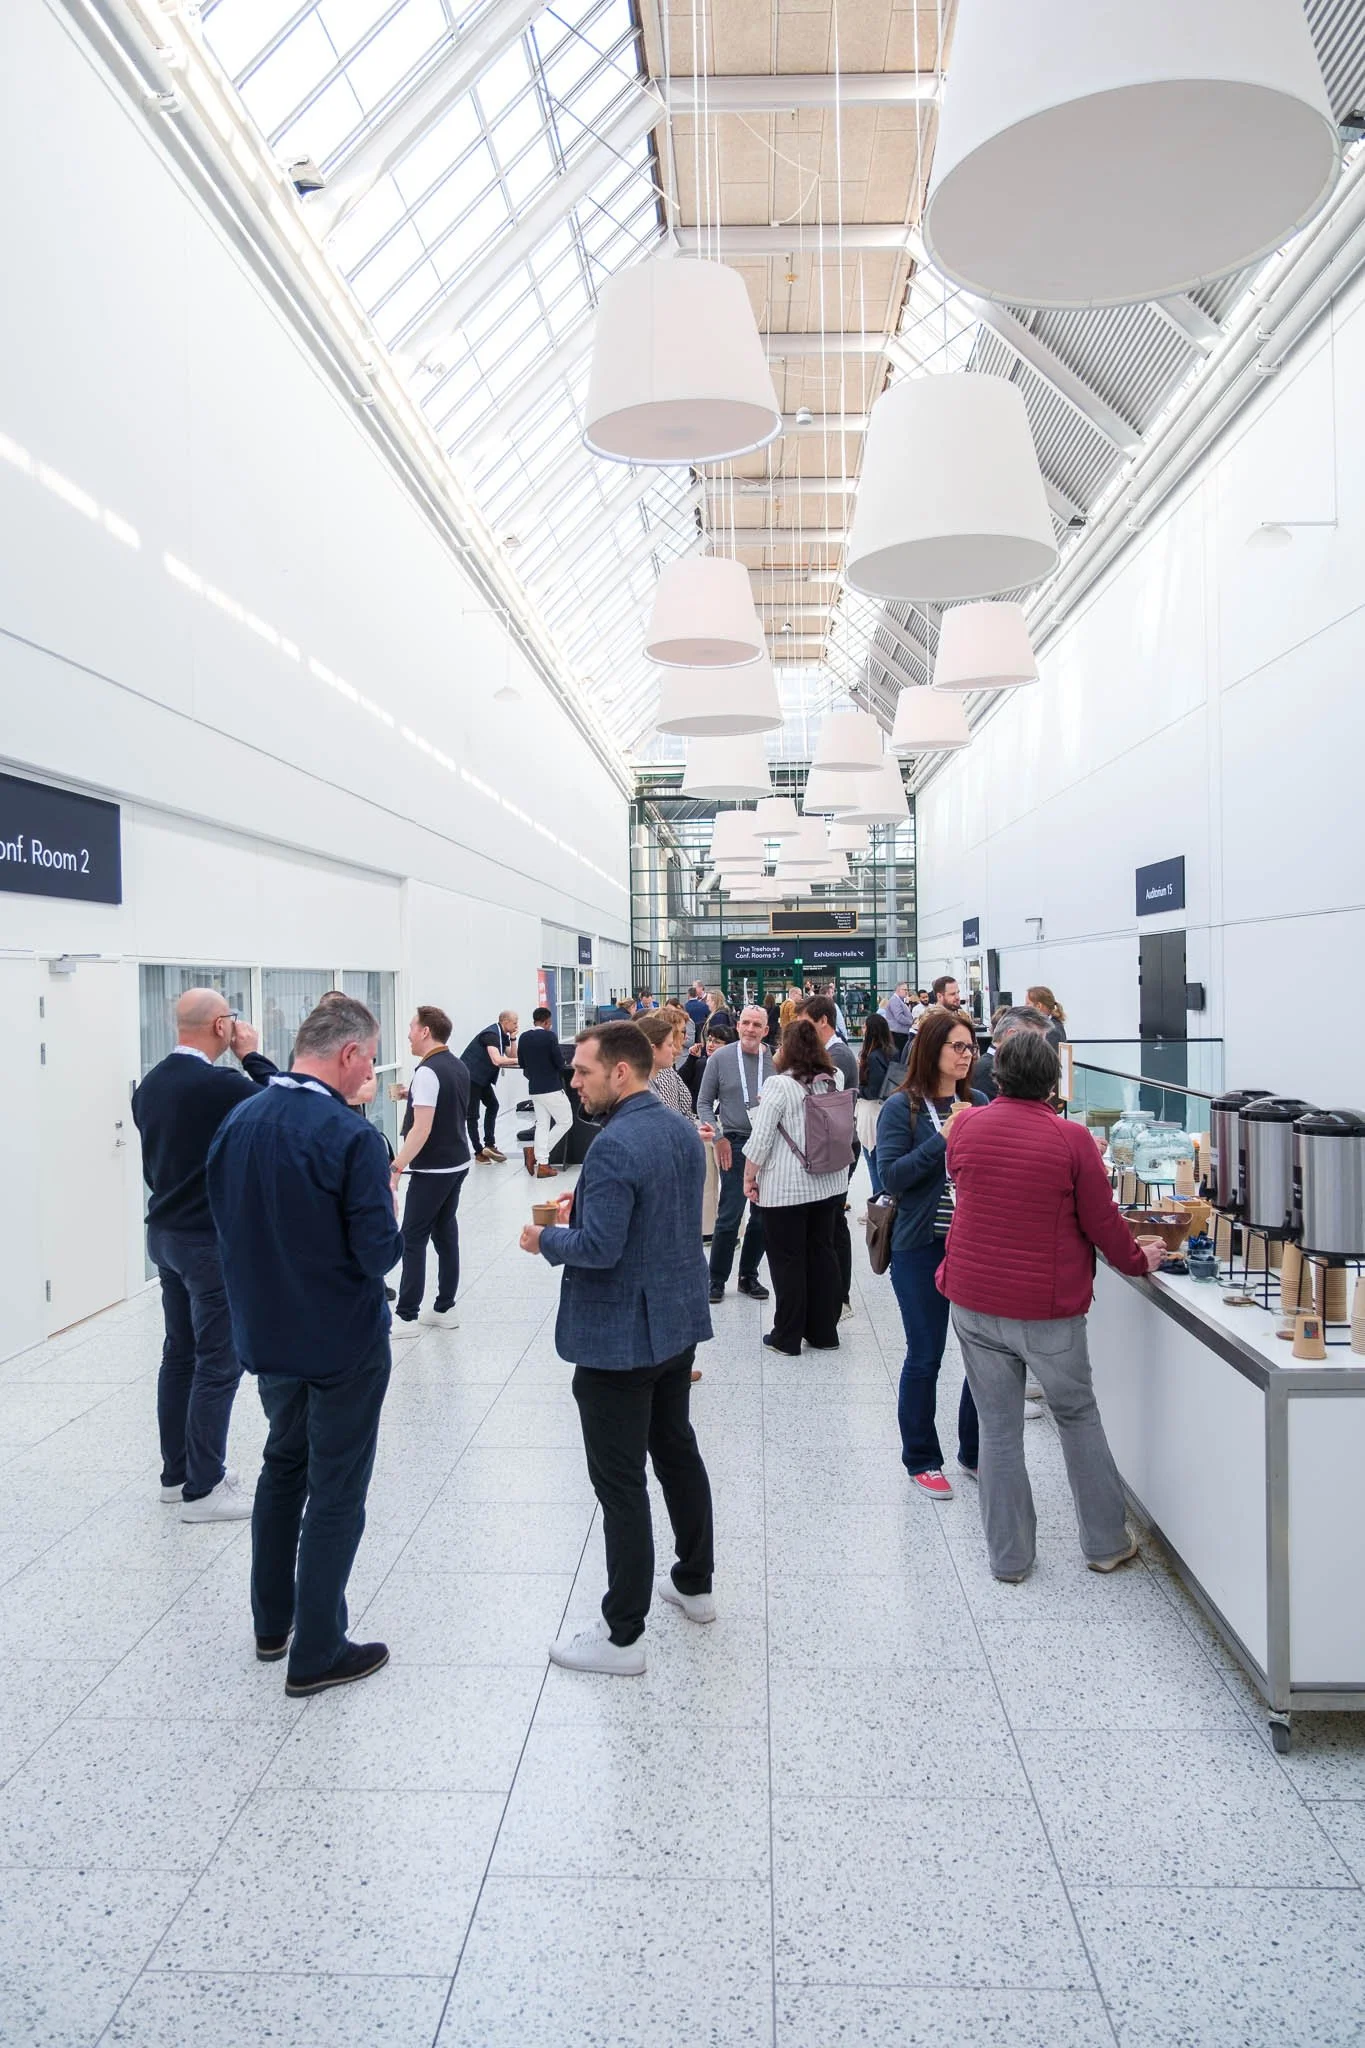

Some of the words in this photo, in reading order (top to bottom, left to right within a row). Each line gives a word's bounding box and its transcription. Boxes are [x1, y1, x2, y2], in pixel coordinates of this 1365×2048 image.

[31, 839, 77, 871] Room
[80, 848, 90, 873] 2
[1145, 887, 1167, 900] Auditorium
[1167, 883, 1173, 896] 15
